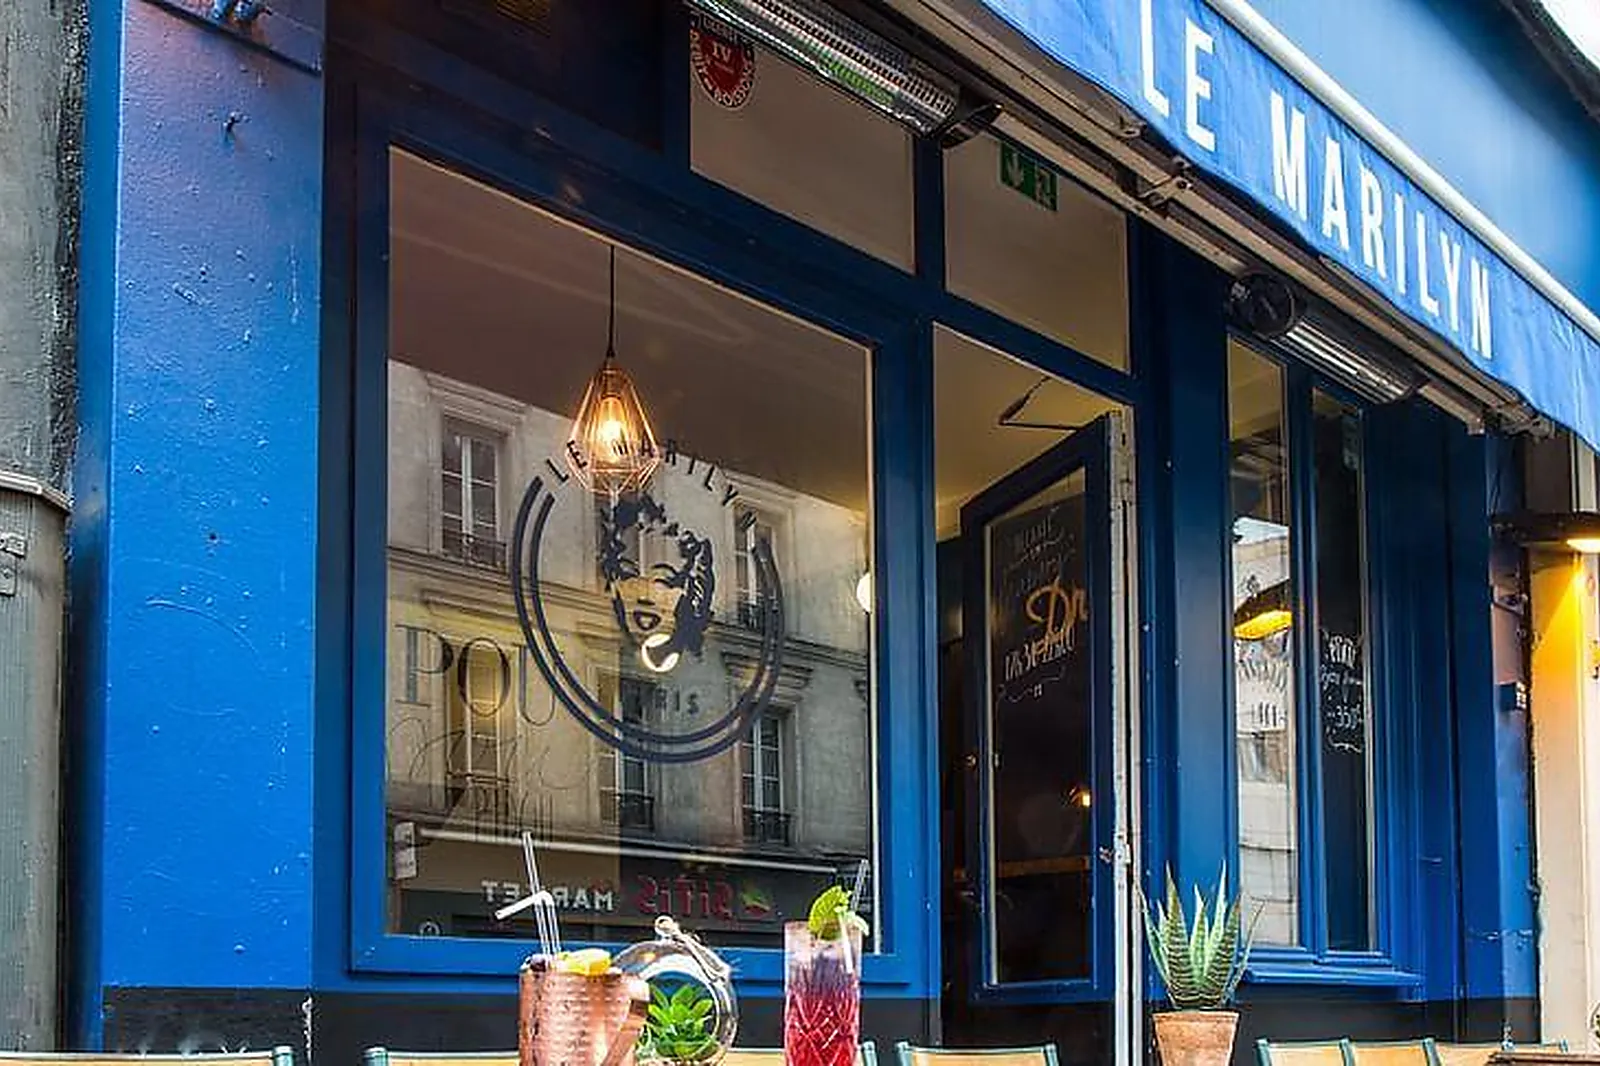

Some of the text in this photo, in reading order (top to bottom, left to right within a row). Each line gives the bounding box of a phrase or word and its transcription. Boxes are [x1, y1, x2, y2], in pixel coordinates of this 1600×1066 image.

[1139, 0, 1493, 360] LE MARILYN
[546, 440, 588, 482] LE
